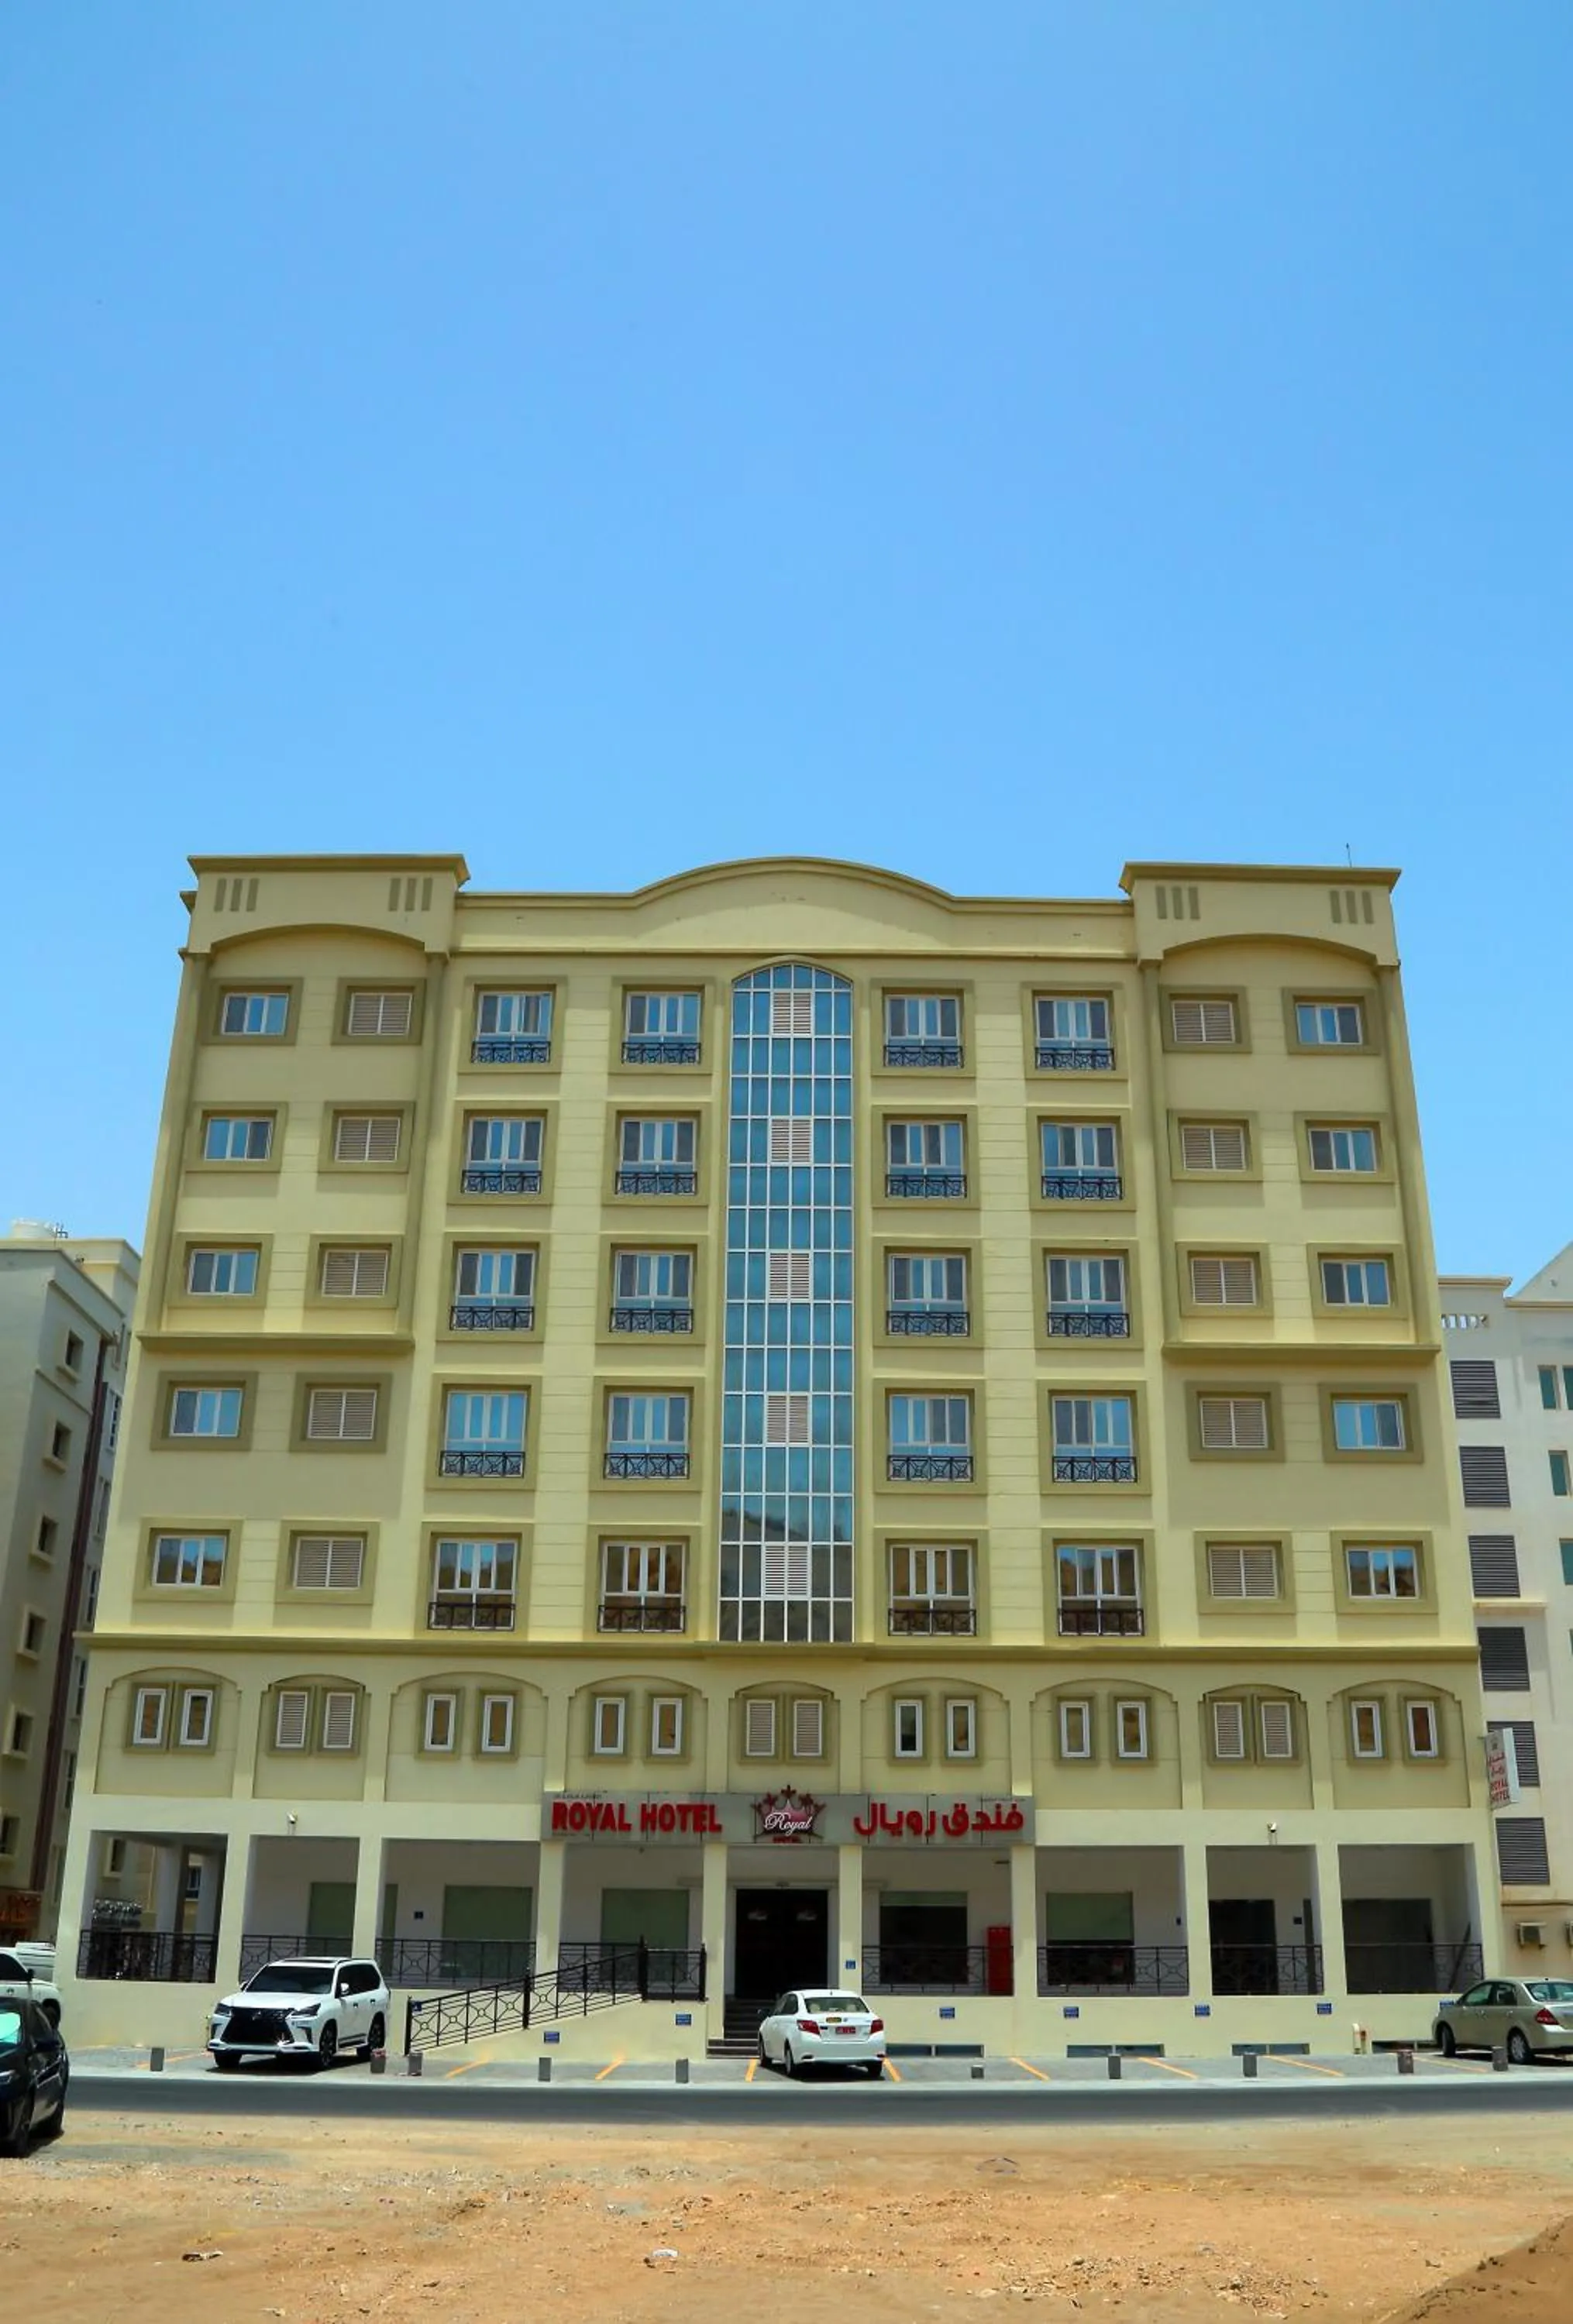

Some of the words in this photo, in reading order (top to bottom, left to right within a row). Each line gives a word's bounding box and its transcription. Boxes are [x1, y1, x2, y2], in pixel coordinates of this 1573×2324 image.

[552, 1801, 632, 1832] ROYAL
[639, 1802, 723, 1833] HOTEL
[763, 1812, 813, 1836] Royal
[852, 1803, 937, 1837] رويال
[941, 1803, 1024, 1836] فندق
